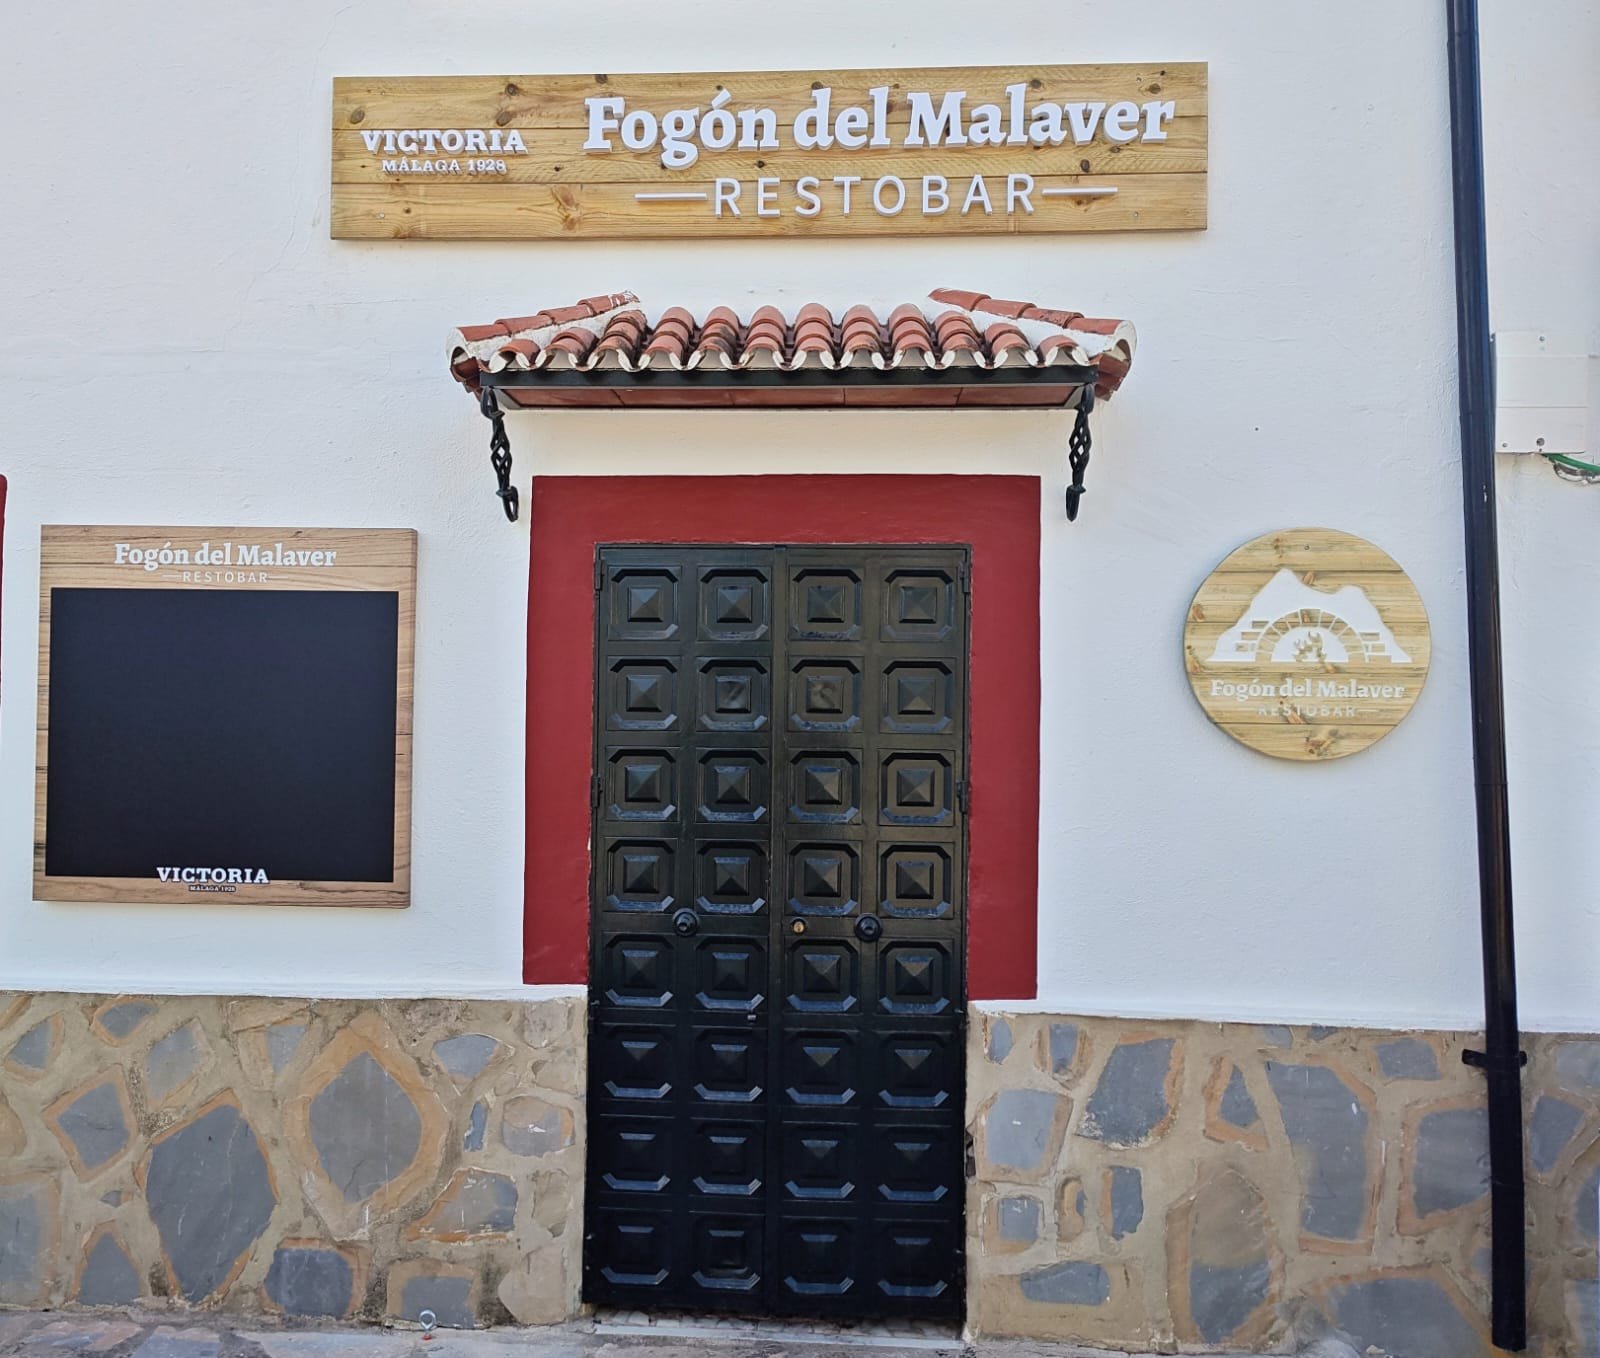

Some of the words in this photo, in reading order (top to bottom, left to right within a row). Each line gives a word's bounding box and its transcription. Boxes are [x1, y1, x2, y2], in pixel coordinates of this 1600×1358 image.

[584, 89, 779, 169] Fogón
[794, 87, 891, 150] del
[904, 83, 1175, 147] Malaver
[361, 130, 528, 156] VICTORIA
[382, 157, 461, 174] MÁLAGA
[467, 159, 506, 174] 1928
[714, 174, 1034, 218] RESTOBAR
[114, 542, 189, 571] Fogón
[195, 543, 233, 566] del
[237, 544, 337, 567] Malaver
[183, 571, 269, 583] RESTOBAR
[1211, 679, 1275, 702] Fogón
[1280, 678, 1312, 697] del
[1317, 679, 1405, 698] Malaver
[1259, 704, 1357, 717] RESTOBAR
[157, 866, 269, 883] VICTORIA
